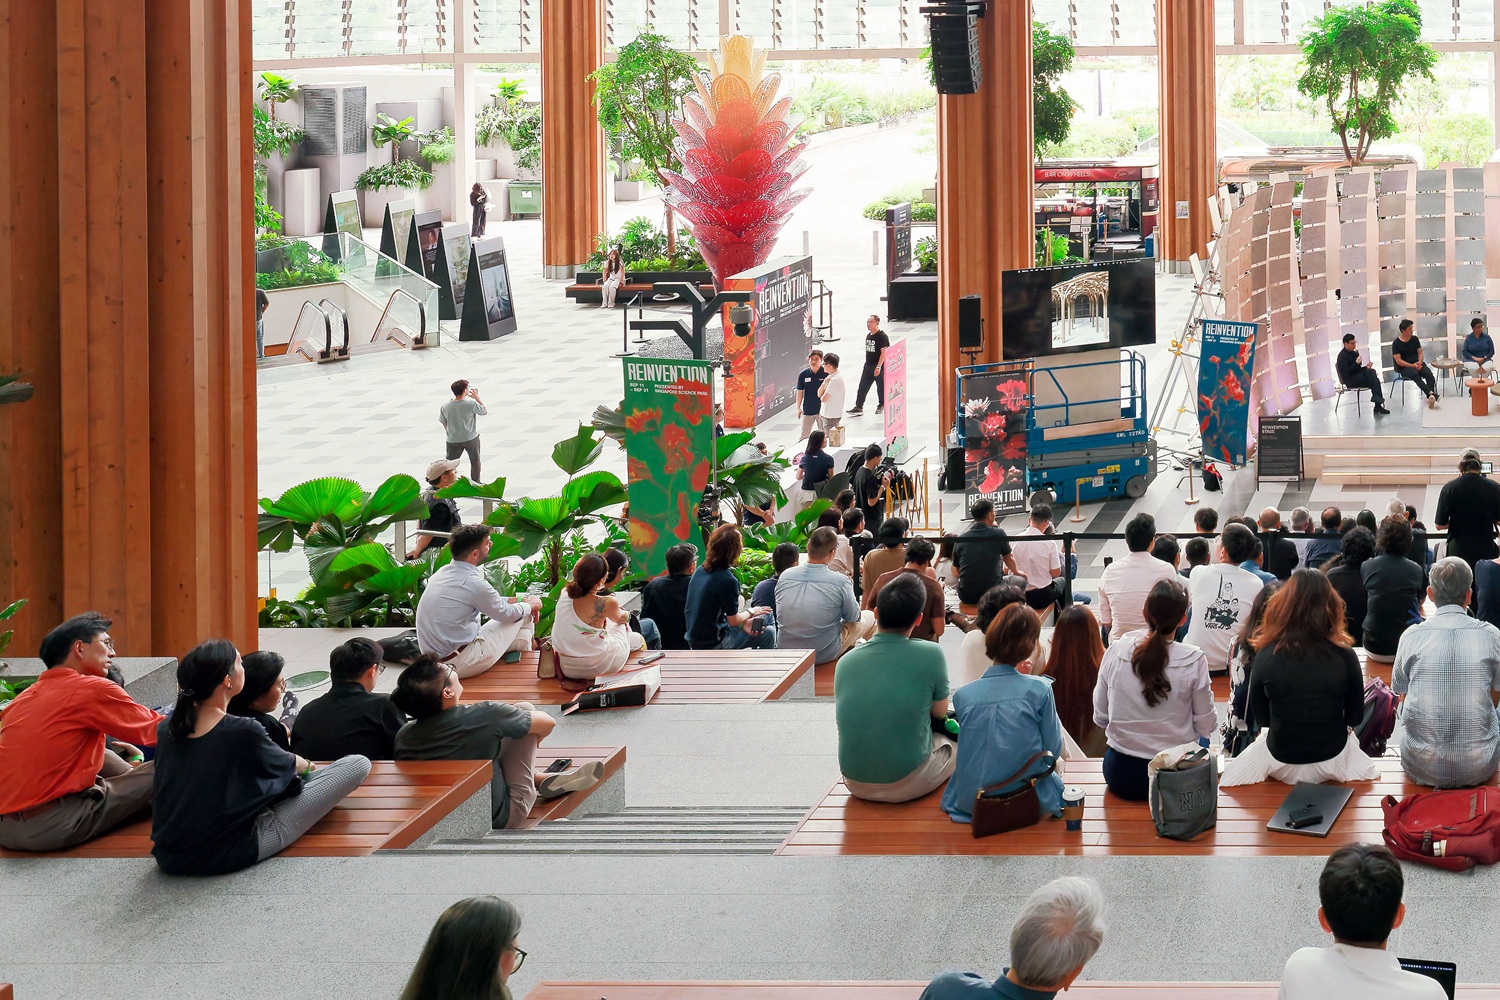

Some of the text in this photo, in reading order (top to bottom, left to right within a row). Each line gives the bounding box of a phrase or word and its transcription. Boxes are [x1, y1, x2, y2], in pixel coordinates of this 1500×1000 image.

[760, 273, 808, 315] REINVENTION
[1205, 323, 1254, 337] REINVENTION
[627, 363, 708, 384] REINVENTION
